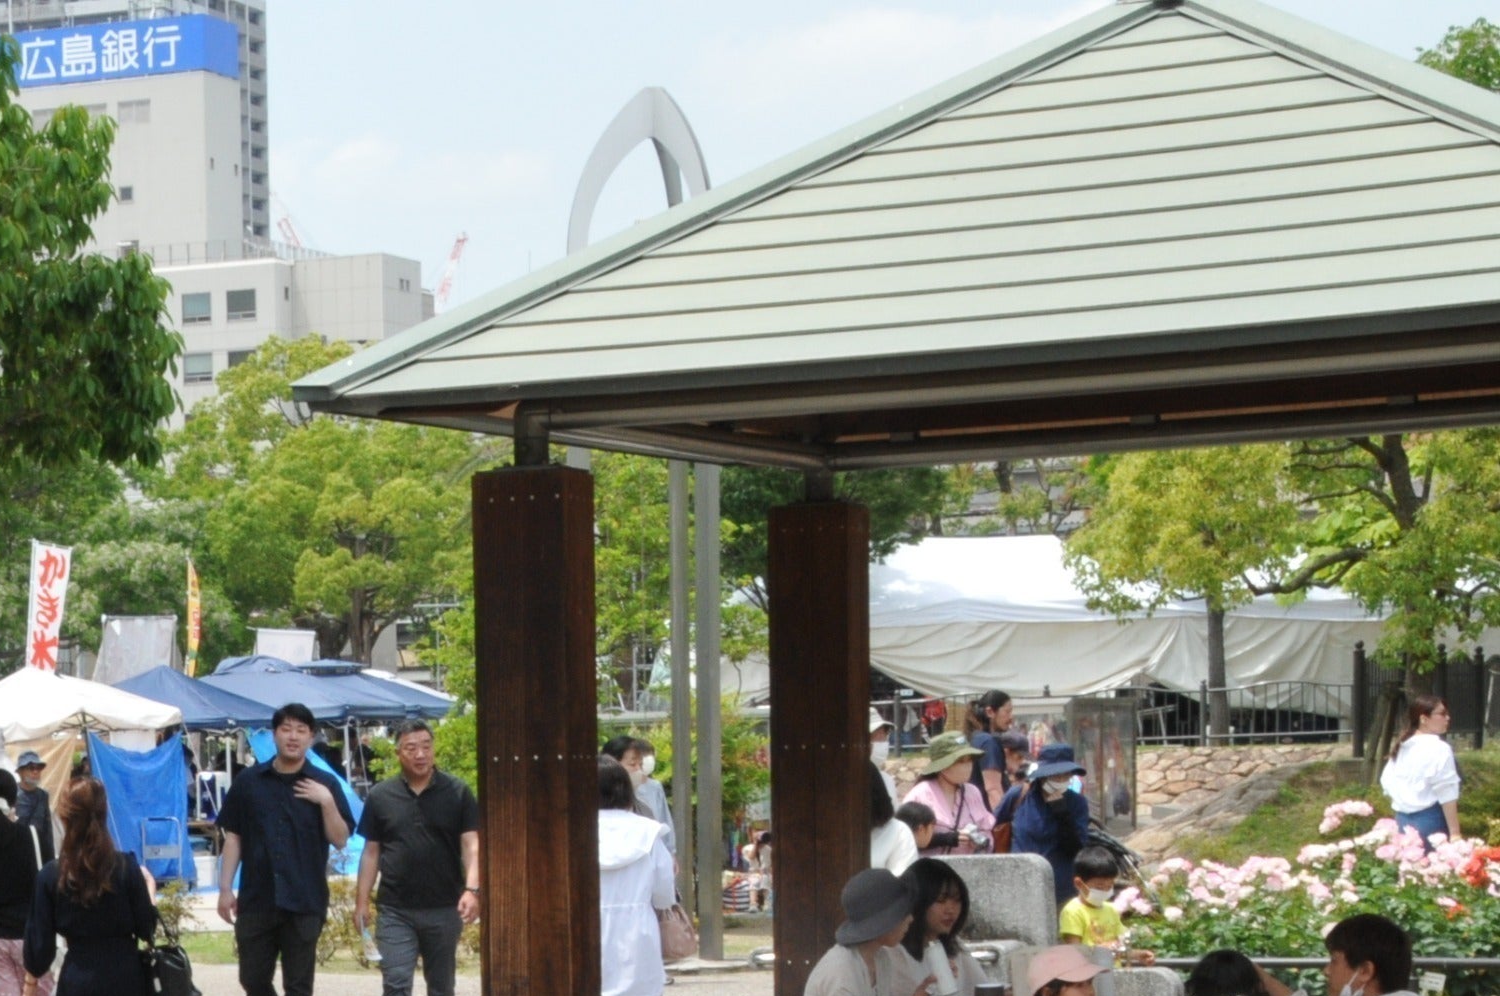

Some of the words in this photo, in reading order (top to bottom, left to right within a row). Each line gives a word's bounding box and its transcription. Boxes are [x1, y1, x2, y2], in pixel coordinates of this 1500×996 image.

[19, 25, 181, 81] 広島銀行
[31, 550, 66, 670] かき氷
